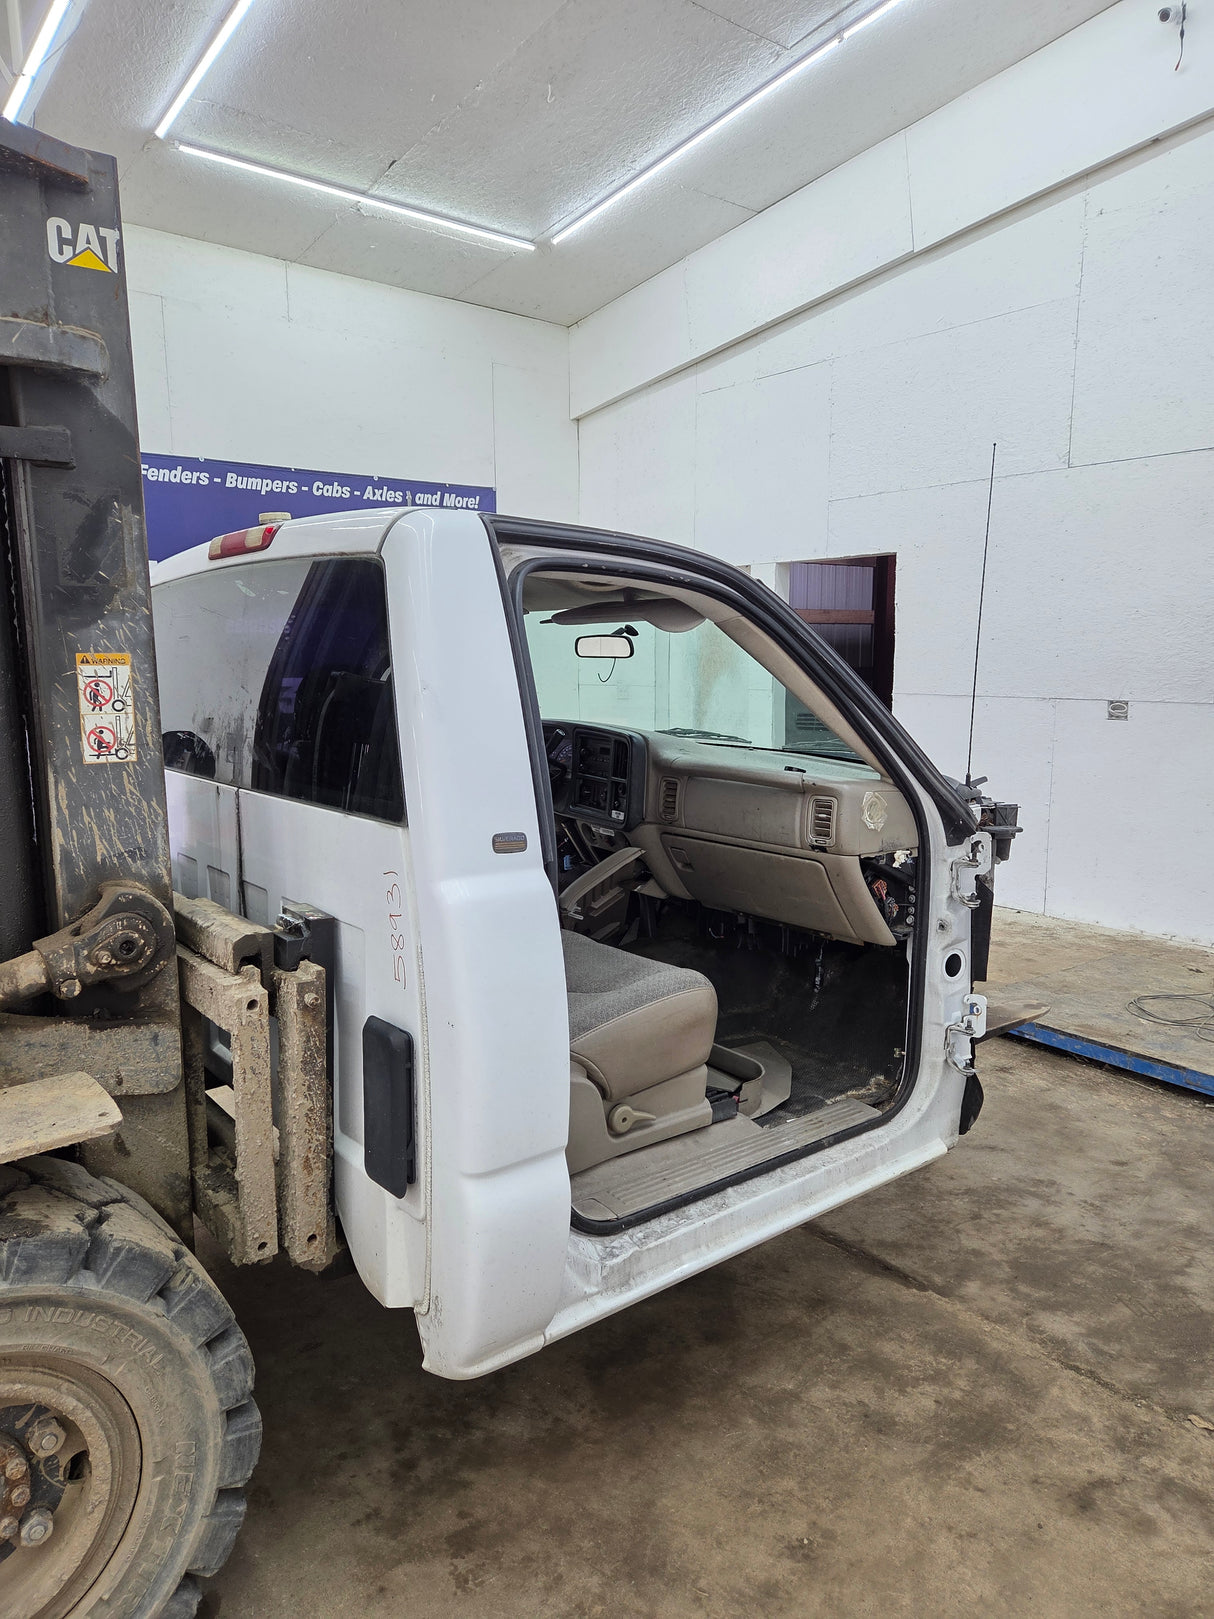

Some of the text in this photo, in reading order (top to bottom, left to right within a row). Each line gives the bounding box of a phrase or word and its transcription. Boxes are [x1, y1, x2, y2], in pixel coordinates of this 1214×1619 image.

[46, 216, 120, 274] CAT
[140, 463, 210, 486] Fenders
[225, 472, 299, 495] Bumpers
[312, 481, 351, 499] Cabs
[363, 485, 403, 503] Axles
[415, 491, 441, 506] and
[443, 493, 480, 509] More!
[23, 1306, 165, 1377] INDUSTRIAL
